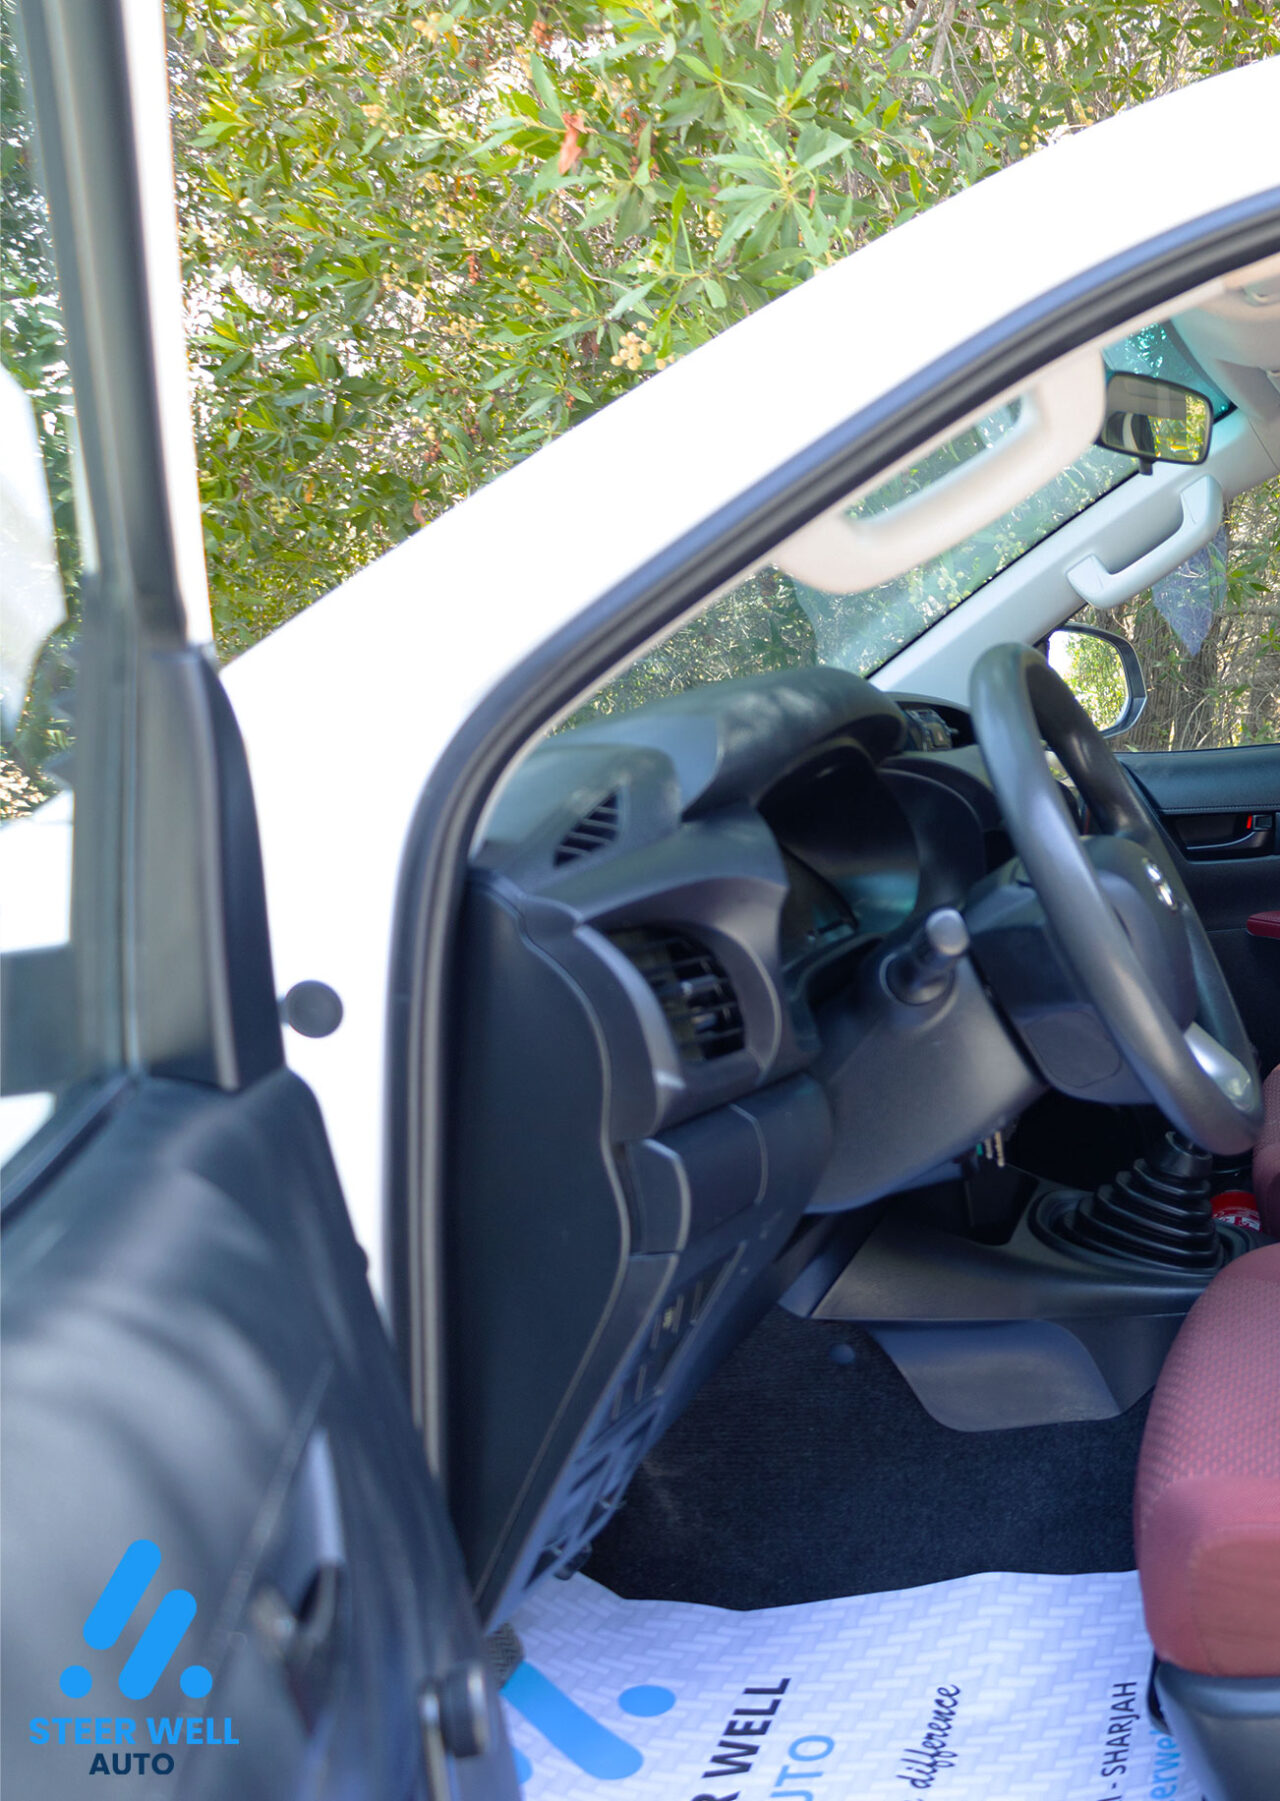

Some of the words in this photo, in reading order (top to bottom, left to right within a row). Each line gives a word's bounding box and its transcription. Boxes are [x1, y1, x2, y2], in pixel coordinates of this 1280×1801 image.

[701, 1677, 791, 1778] WELL
[896, 1684, 961, 1789] difference
[1101, 1682, 1141, 1777] SHARJAH
